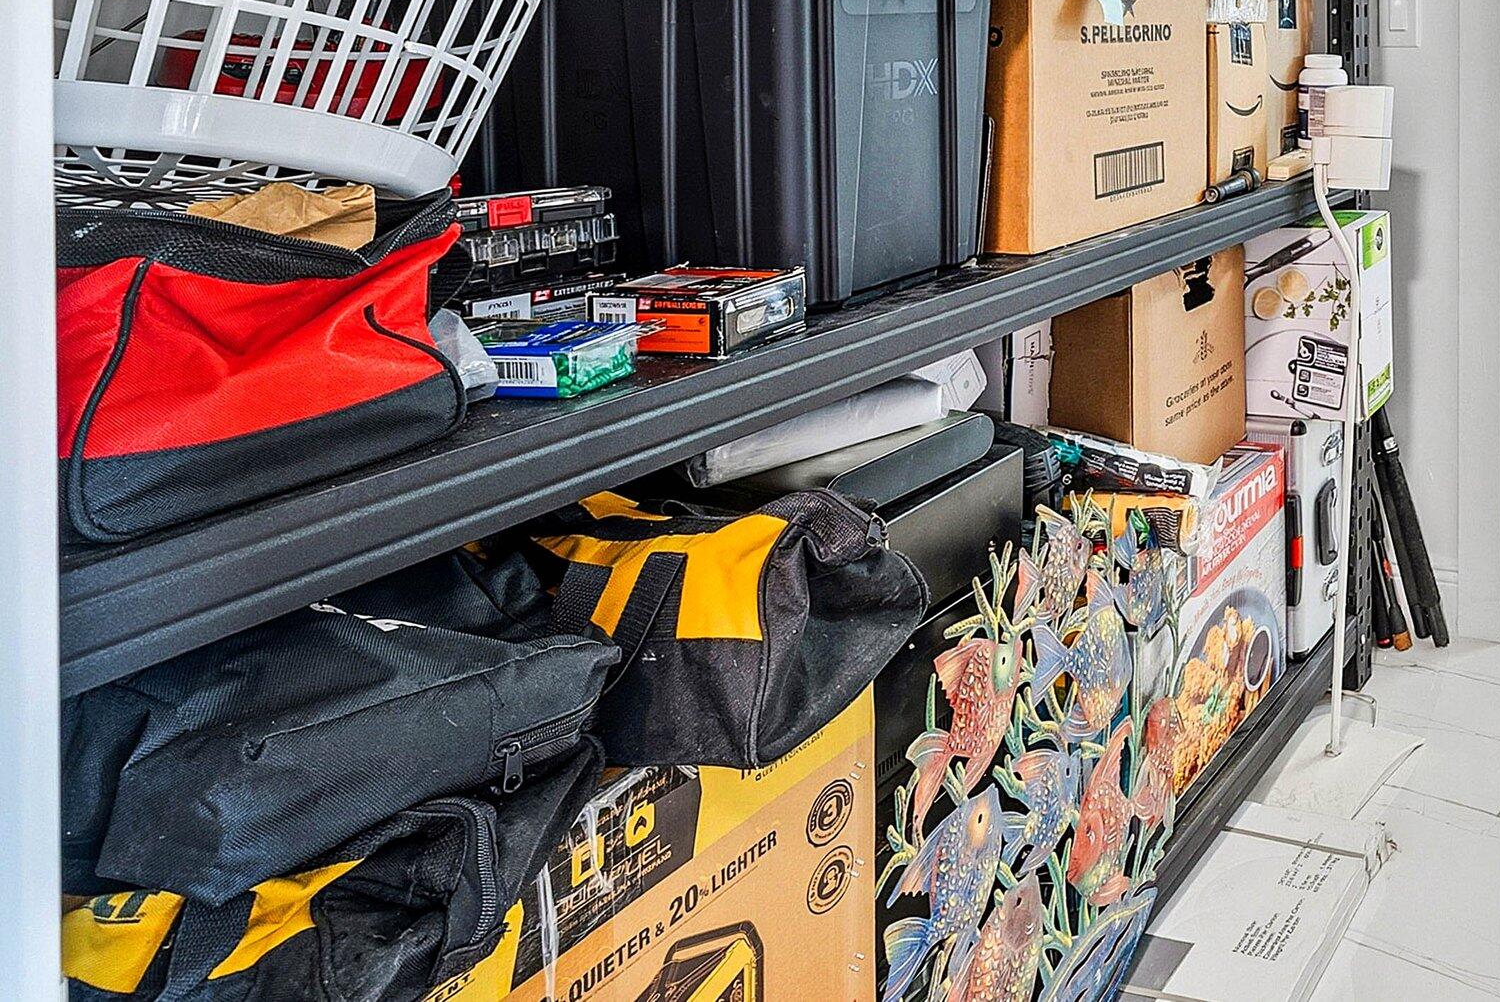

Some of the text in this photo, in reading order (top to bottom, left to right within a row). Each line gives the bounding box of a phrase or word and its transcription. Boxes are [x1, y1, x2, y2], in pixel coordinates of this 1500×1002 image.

[1080, 23, 1172, 44] S.PELLEGRINO
[867, 58, 939, 100] HDX
[1208, 462, 1278, 531] ourmia
[567, 926, 651, 1002] QUIETER
[653, 918, 667, 938] &
[667, 883, 710, 928] 20%
[709, 829, 779, 897] LIGHTER
